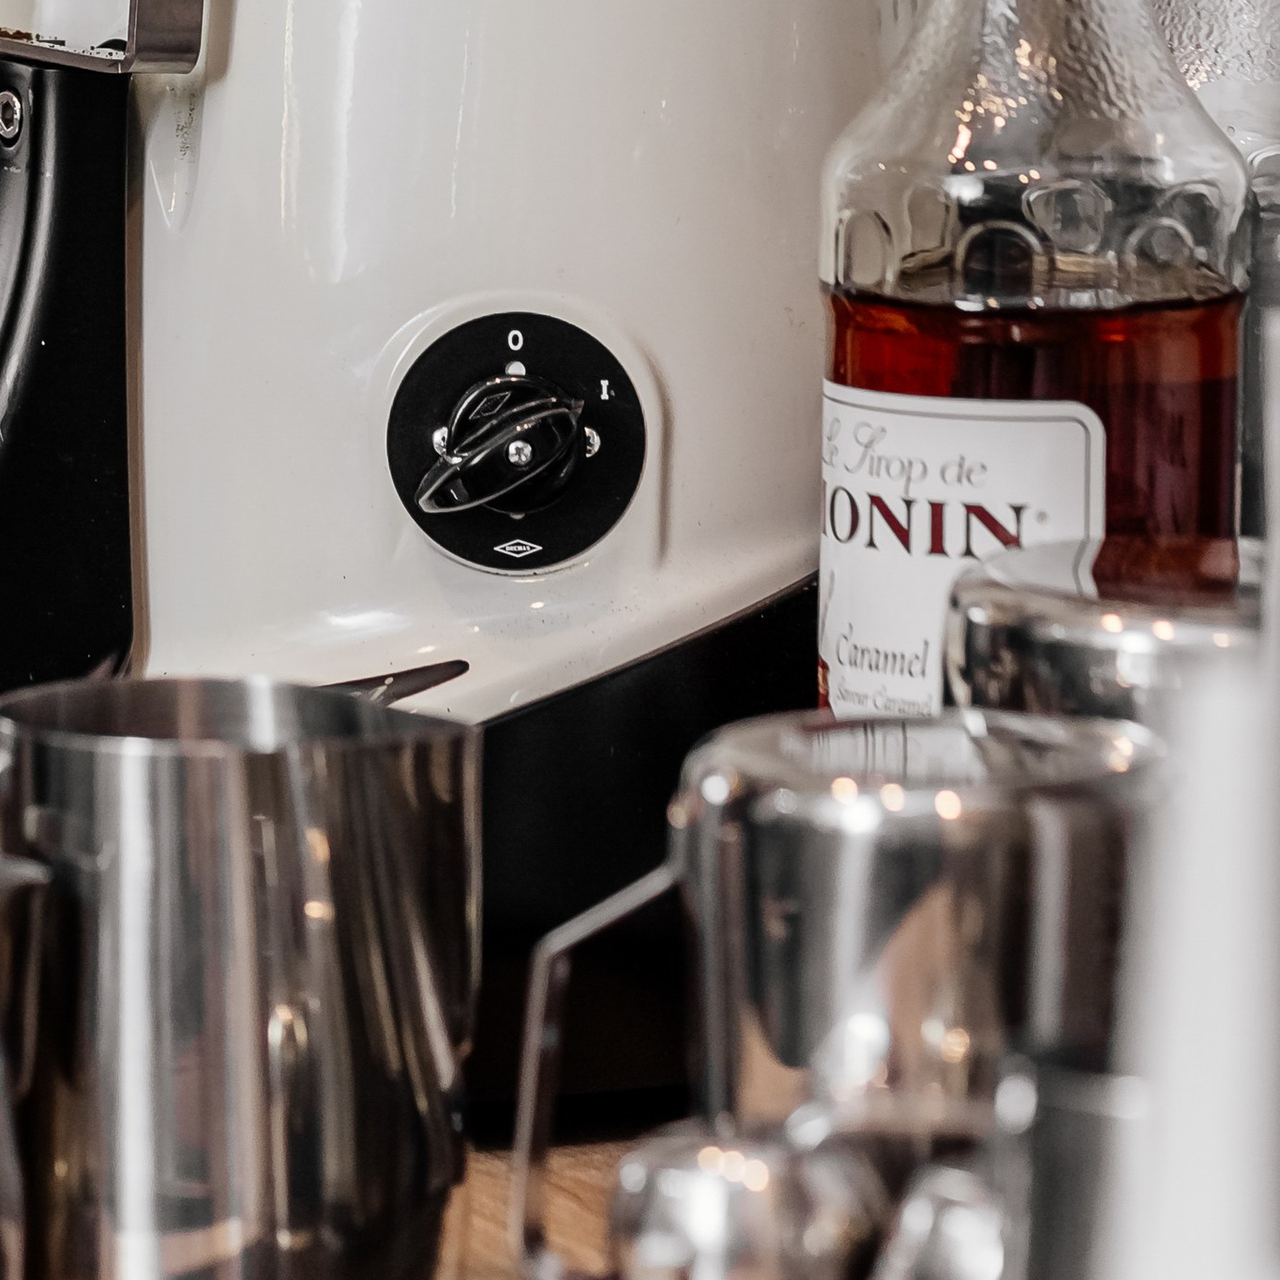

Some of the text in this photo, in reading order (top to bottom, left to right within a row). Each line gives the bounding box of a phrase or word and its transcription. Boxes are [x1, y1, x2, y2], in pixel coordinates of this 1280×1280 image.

[843, 421, 929, 498] Sirop
[939, 452, 989, 488] de
[822, 483, 1029, 561] ONIN
[836, 622, 930, 678] Caramel
